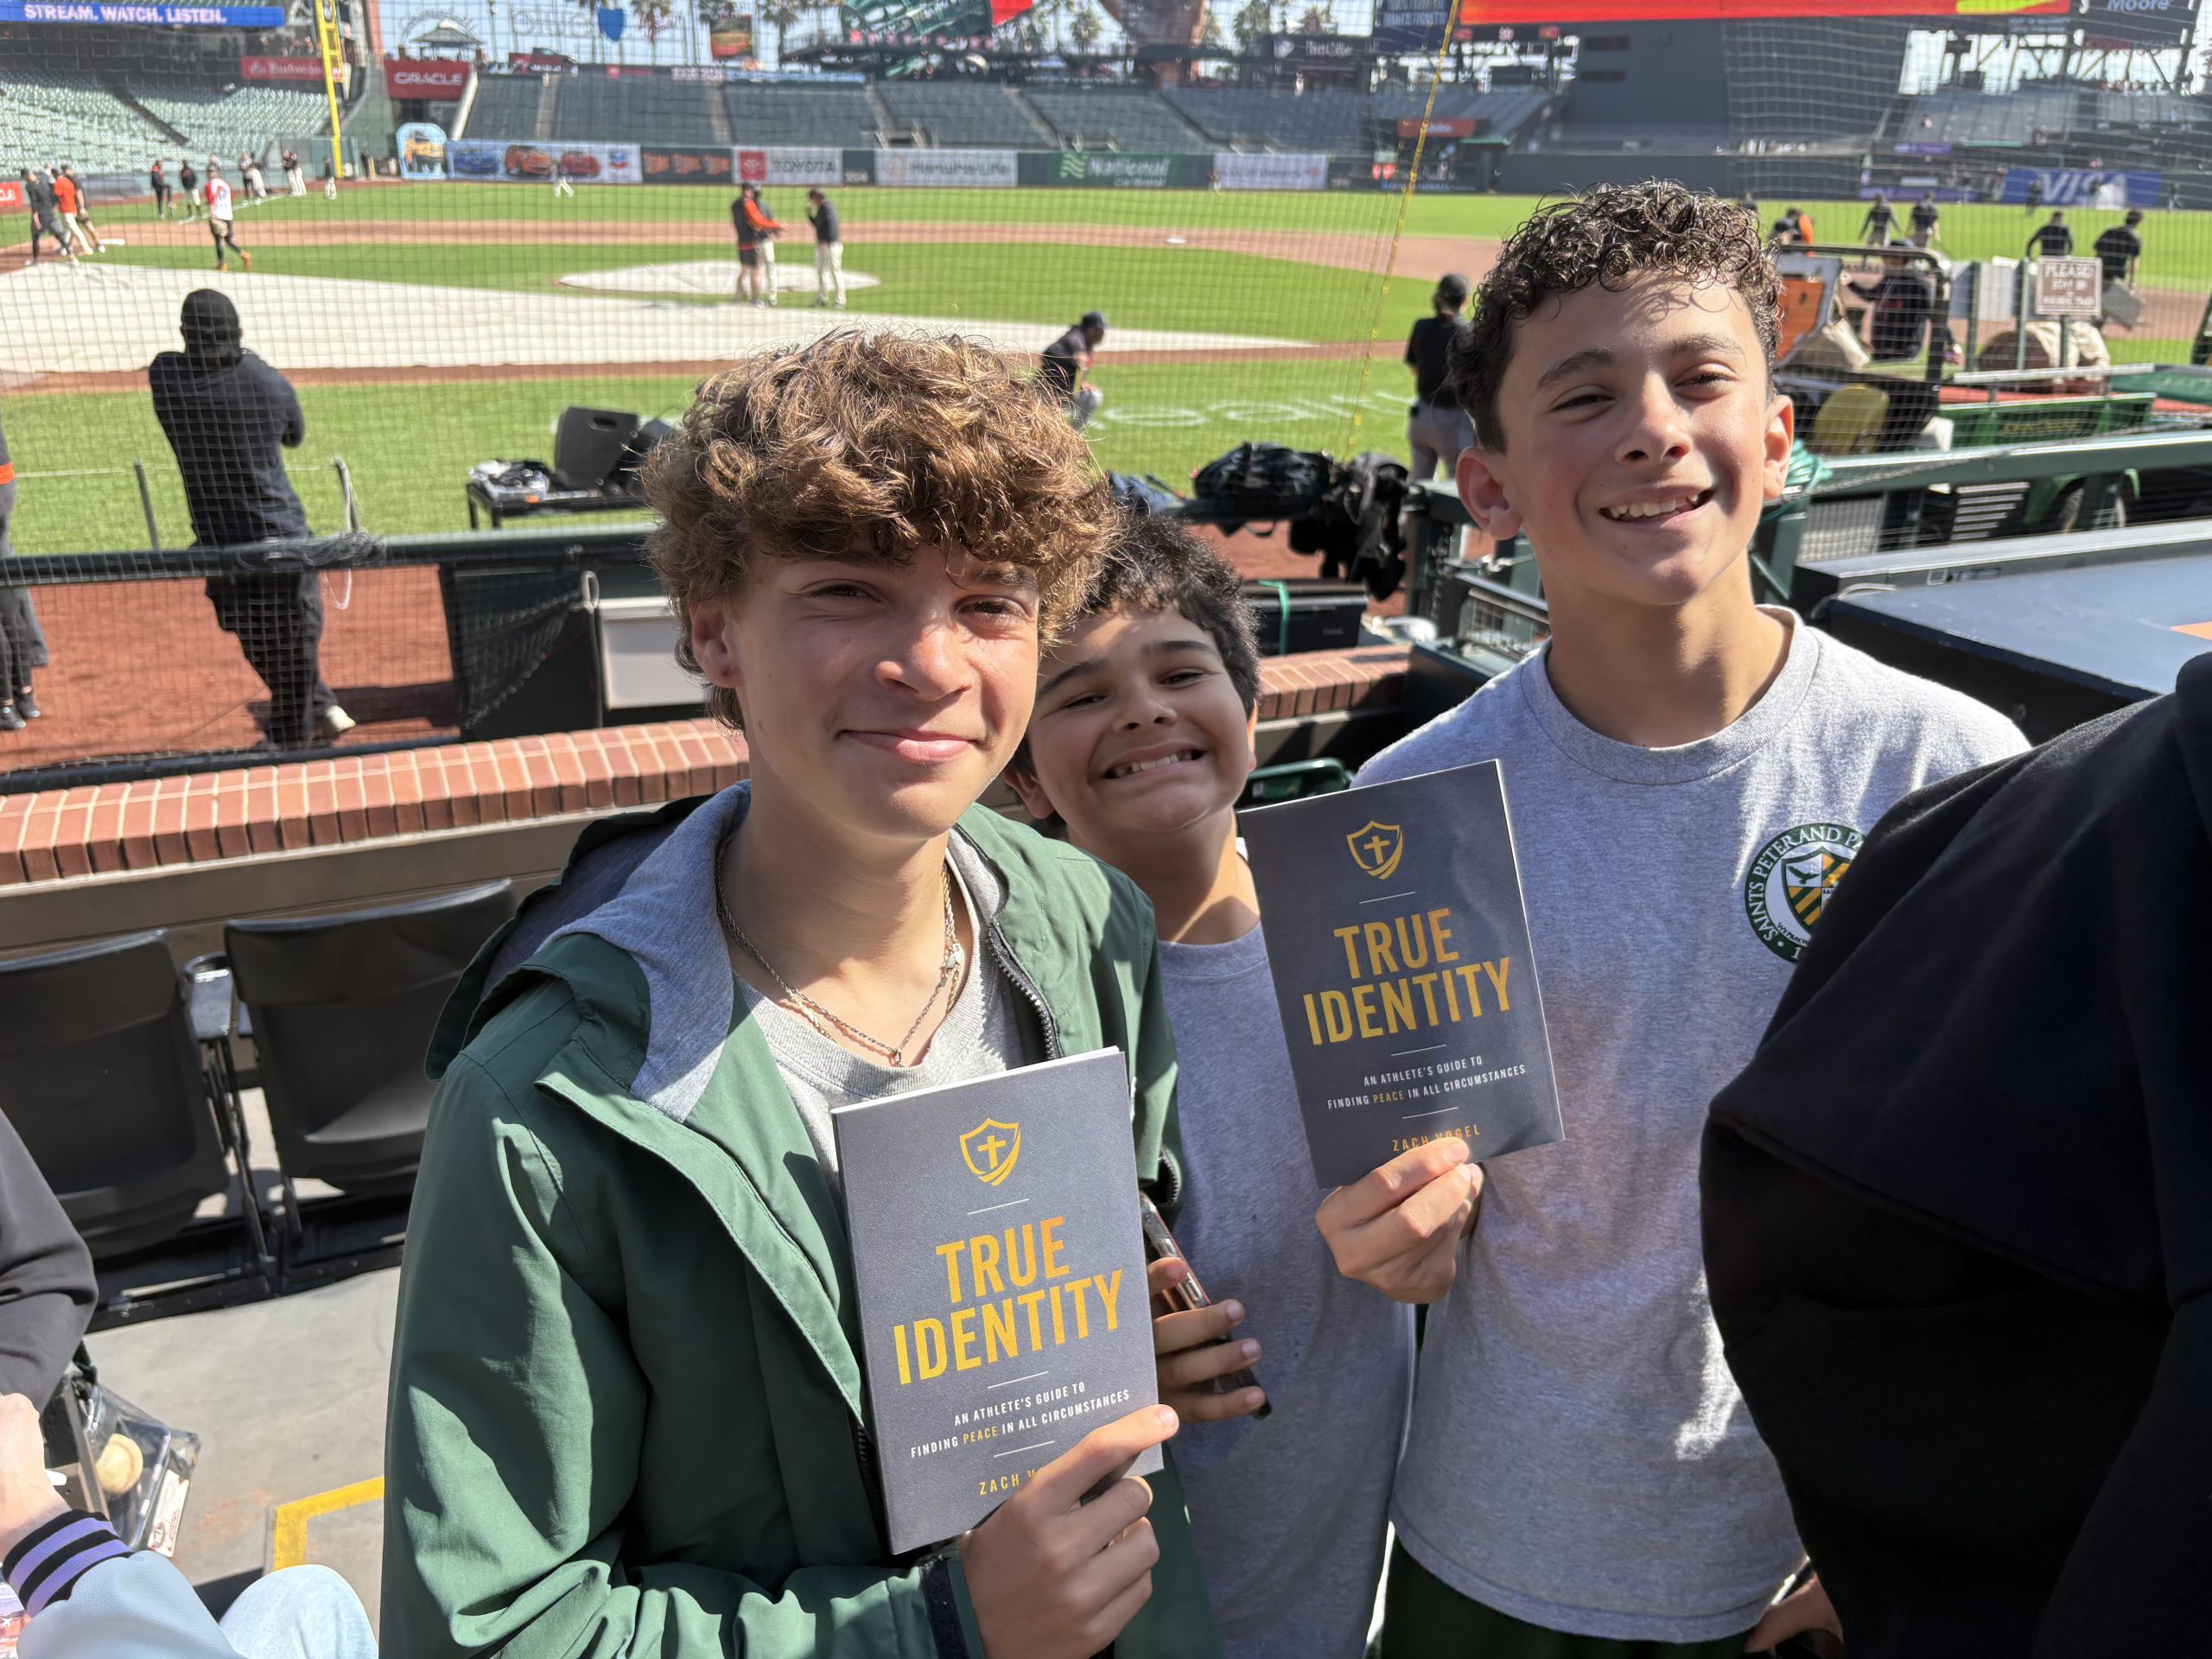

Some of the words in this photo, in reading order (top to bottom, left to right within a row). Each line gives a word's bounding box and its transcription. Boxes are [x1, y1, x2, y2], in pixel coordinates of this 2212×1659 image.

[24, 4, 98, 21] STREAM.
[99, 6, 163, 22] WATCH.
[167, 8, 226, 24] LISTEN.
[394, 72, 462, 86] ORACLE
[772, 160, 836, 173] TOYOTA
[1089, 156, 1171, 176] National
[1798, 826, 1841, 843] AND
[1753, 836, 1800, 879] PETER
[1749, 881, 1777, 941] SAINTS
[1334, 907, 1459, 980] TRUE
[1303, 957, 1510, 1046] IDENTITY
[1327, 1095, 1370, 1110] FINDING
[1373, 1090, 1405, 1104] PEACE
[1408, 1087, 1420, 1099] IN
[1423, 1084, 1441, 1096] ALL
[1443, 1064, 1527, 1092] CIRCUMSTANCES
[1363, 1076, 1377, 1087] AN
[1380, 1065, 1434, 1084] ATHLETE'S
[1437, 1059, 1467, 1075] GUIDE
[1471, 1055, 1483, 1067] TO
[1392, 1135, 1429, 1152] ZACH
[936, 1216, 1071, 1304] TRUE
[893, 1269, 1122, 1385] IDENTITY
[911, 1436, 959, 1458] FINDING
[963, 1427, 999, 1444] PEACE
[1001, 1422, 1014, 1434] IN
[1019, 1416, 1038, 1431] ALL
[1041, 1389, 1130, 1425] CIRCUMSTANCES
[954, 1412, 969, 1426] AN
[973, 1396, 1033, 1421] ATHLETE'S
[1035, 1386, 1069, 1406] GUIDE
[1071, 1382, 1085, 1395] TO
[979, 1473, 1020, 1496] ZACH
